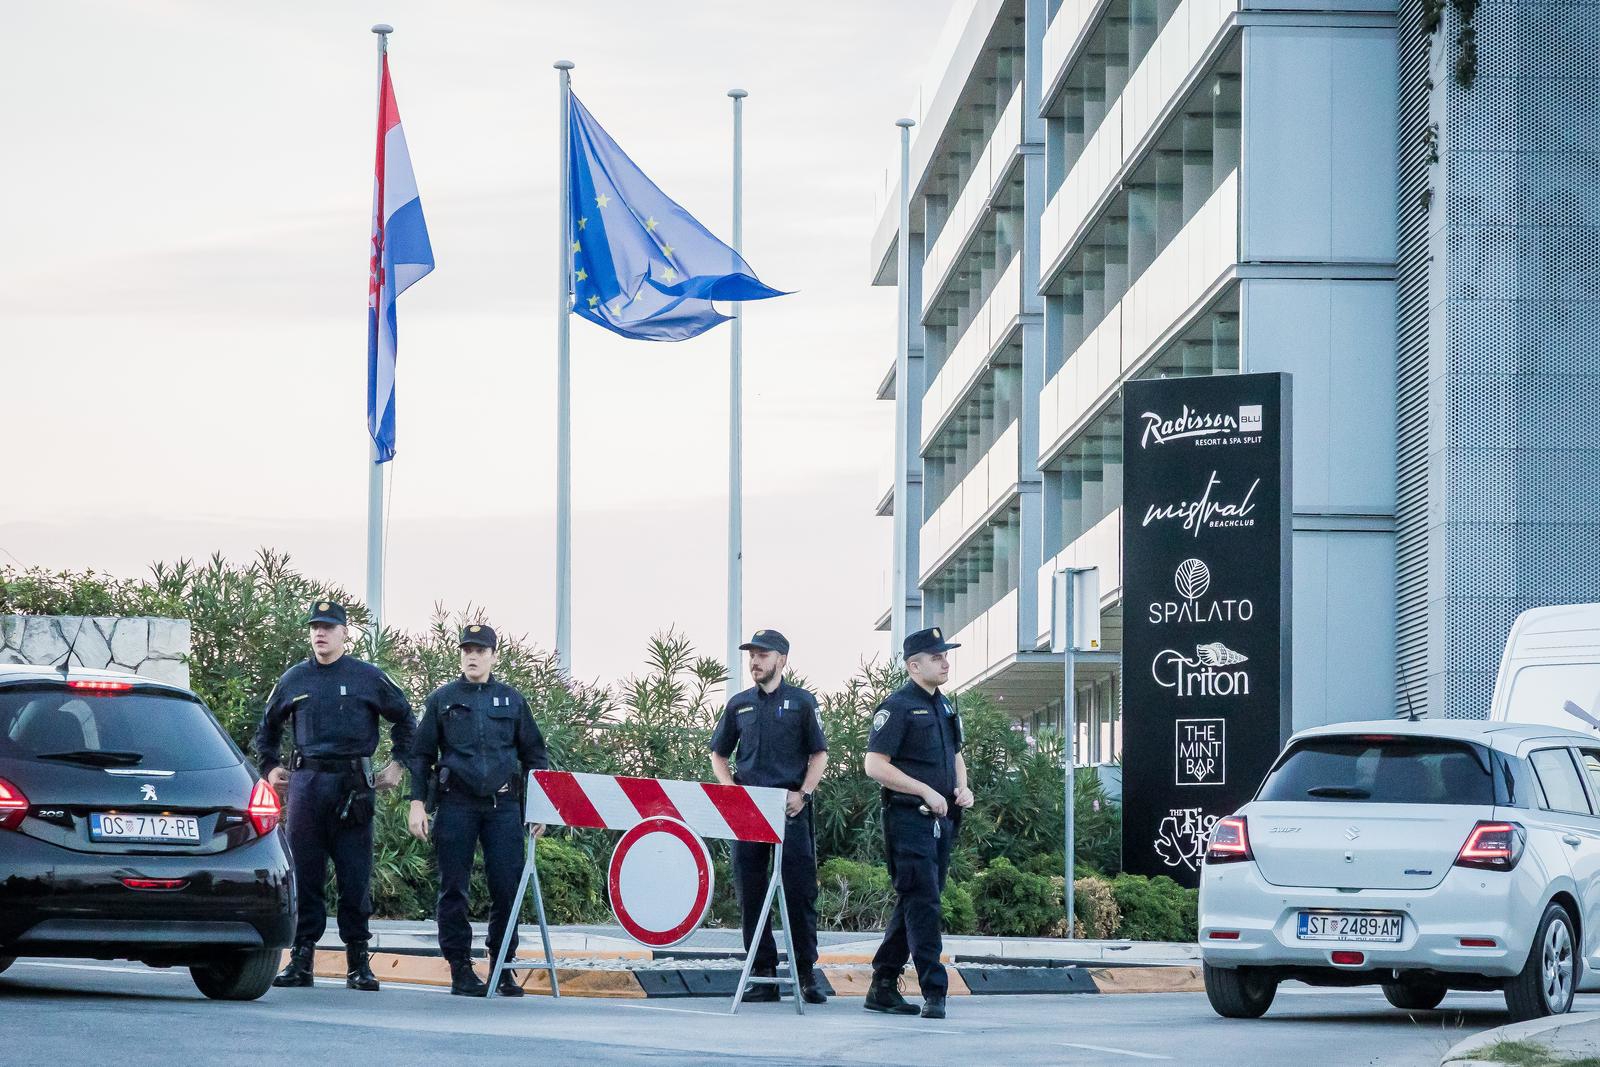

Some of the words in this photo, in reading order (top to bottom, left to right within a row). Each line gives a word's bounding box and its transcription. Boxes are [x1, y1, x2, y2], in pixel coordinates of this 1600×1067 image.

[1141, 404, 1238, 449] Radisson
[1240, 415, 1261, 423] BLU
[1195, 438, 1221, 446] RESORT
[1229, 437, 1242, 445] SPA
[1243, 436, 1262, 444] SPLIT
[1142, 470, 1260, 537] mistral
[1209, 519, 1254, 528] BEACHCLUB
[1149, 599, 1253, 624] SPALATO
[1152, 649, 1250, 697] Triton
[1184, 725, 1216, 742] THE
[1179, 741, 1222, 759] MINT
[1186, 758, 1215, 782] BAR
[38, 810, 65, 818] 208
[1169, 809, 1184, 817] THE
[103, 816, 125, 835] OS
[1310, 917, 1329, 934] ST
